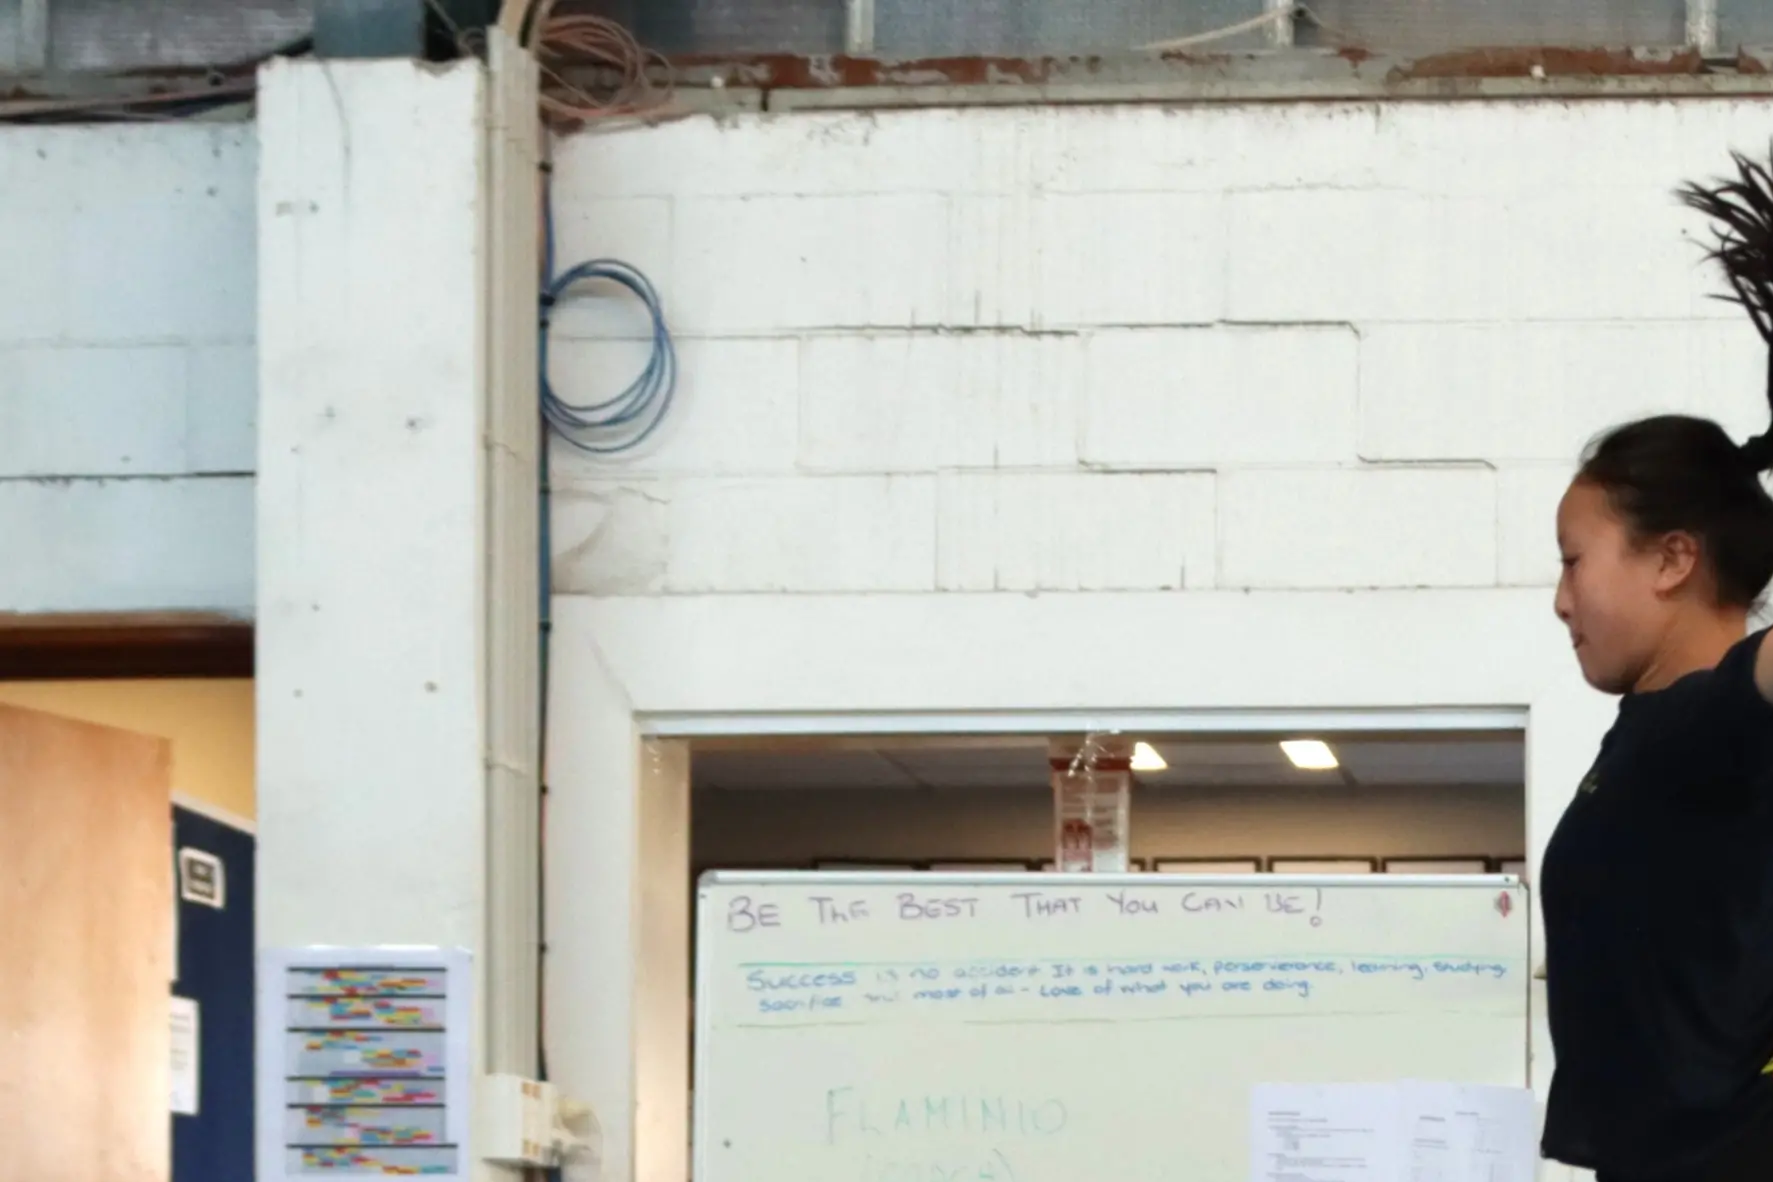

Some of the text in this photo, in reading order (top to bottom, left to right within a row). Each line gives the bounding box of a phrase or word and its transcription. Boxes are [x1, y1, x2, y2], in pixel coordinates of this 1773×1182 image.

[728, 896, 781, 932] BE
[898, 892, 980, 920] BEST
[1011, 891, 1083, 918] THAT
[909, 967, 941, 980] no
[827, 1085, 1068, 1146] FLAMINIO
